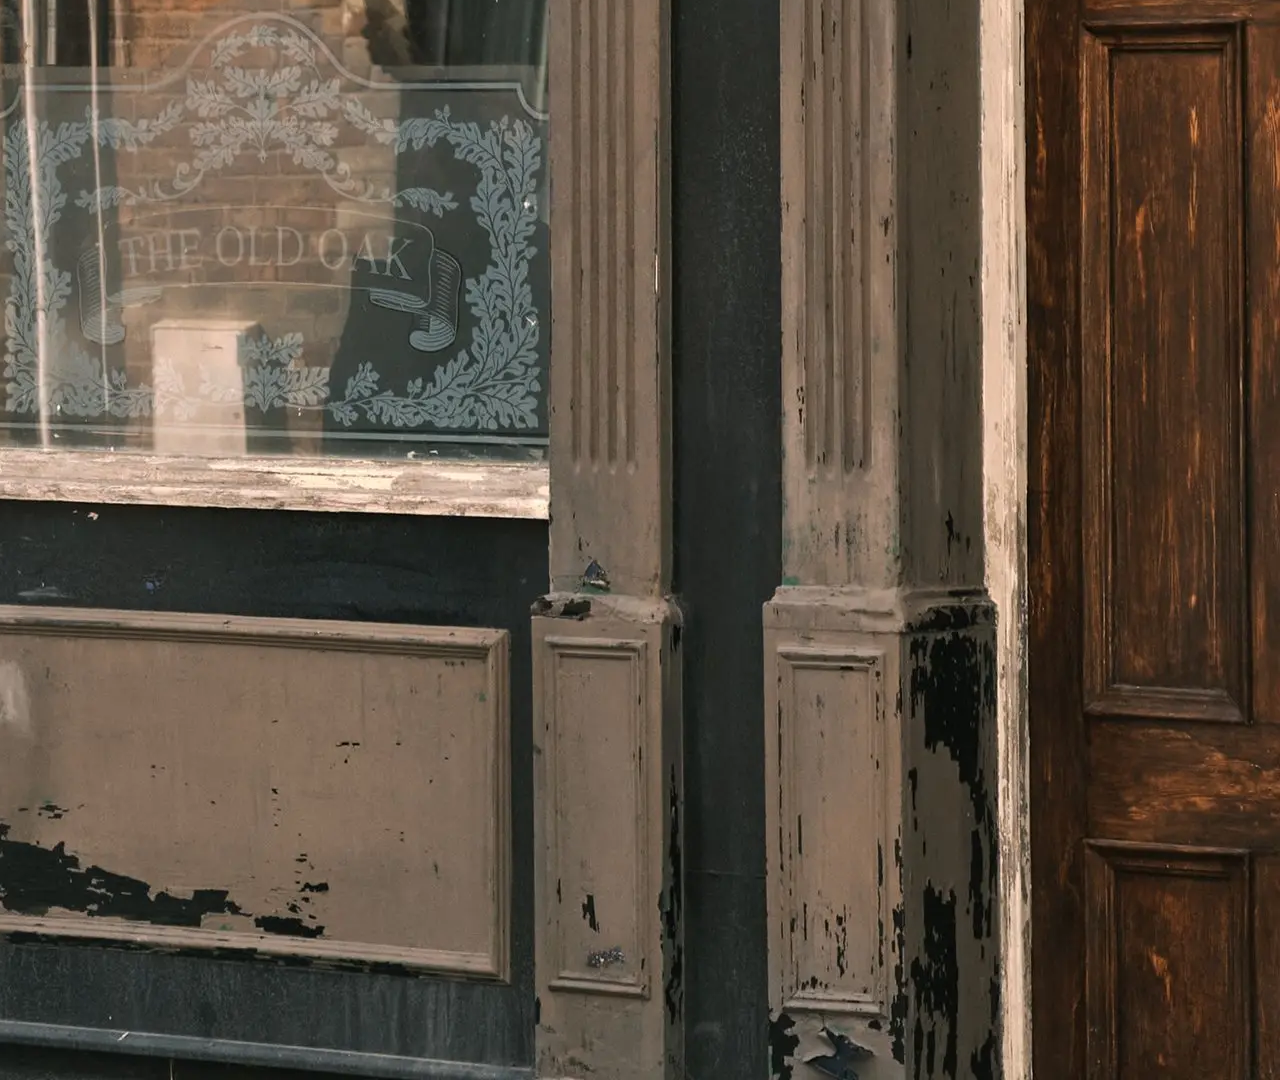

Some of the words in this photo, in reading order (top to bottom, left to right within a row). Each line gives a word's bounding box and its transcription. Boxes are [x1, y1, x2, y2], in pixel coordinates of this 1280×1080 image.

[118, 228, 203, 277] THE
[215, 225, 304, 267] OLD
[318, 228, 414, 281] OAK
